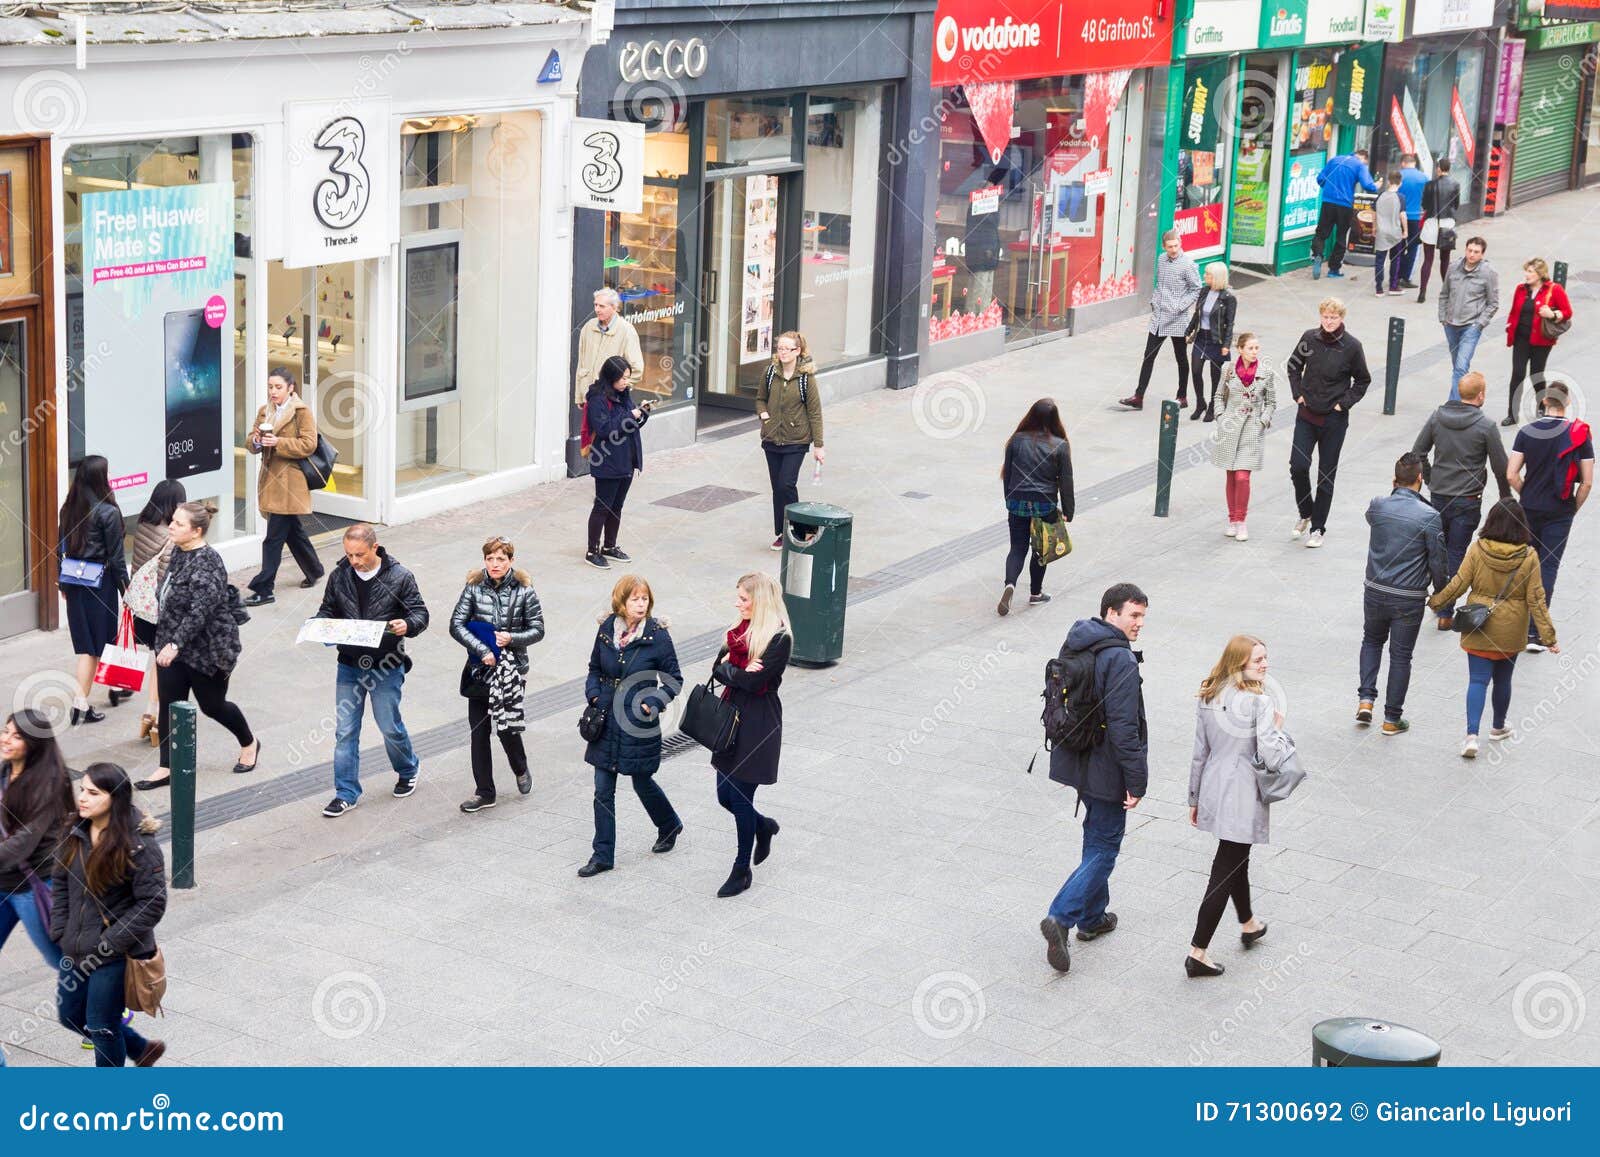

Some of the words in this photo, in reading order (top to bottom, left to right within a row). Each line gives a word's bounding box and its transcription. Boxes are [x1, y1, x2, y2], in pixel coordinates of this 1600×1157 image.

[961, 16, 1041, 52] vodafone
[1080, 19, 1096, 43] 48
[1098, 17, 1140, 42] Grafton
[1141, 15, 1156, 39] St.
[1194, 25, 1223, 45] Griffins
[1329, 15, 1358, 34] Foodhall
[619, 37, 708, 84] ecco
[1348, 58, 1366, 120] SUBWAY
[1187, 77, 1208, 145] SUBWAY
[95, 210, 137, 234] Free
[95, 235, 143, 260] Mate
[147, 231, 162, 255] S
[323, 233, 358, 249] Three.ie
[95, 269, 109, 279] with
[110, 268, 123, 277] Free
[134, 266, 145, 274] and
[146, 264, 155, 273] All
[155, 263, 166, 272] You
[167, 261, 178, 270] Can
[180, 260, 189, 268] Eat
[190, 259, 204, 267] Data
[168, 438, 194, 456] 08:08
[118, 477, 133, 488] store
